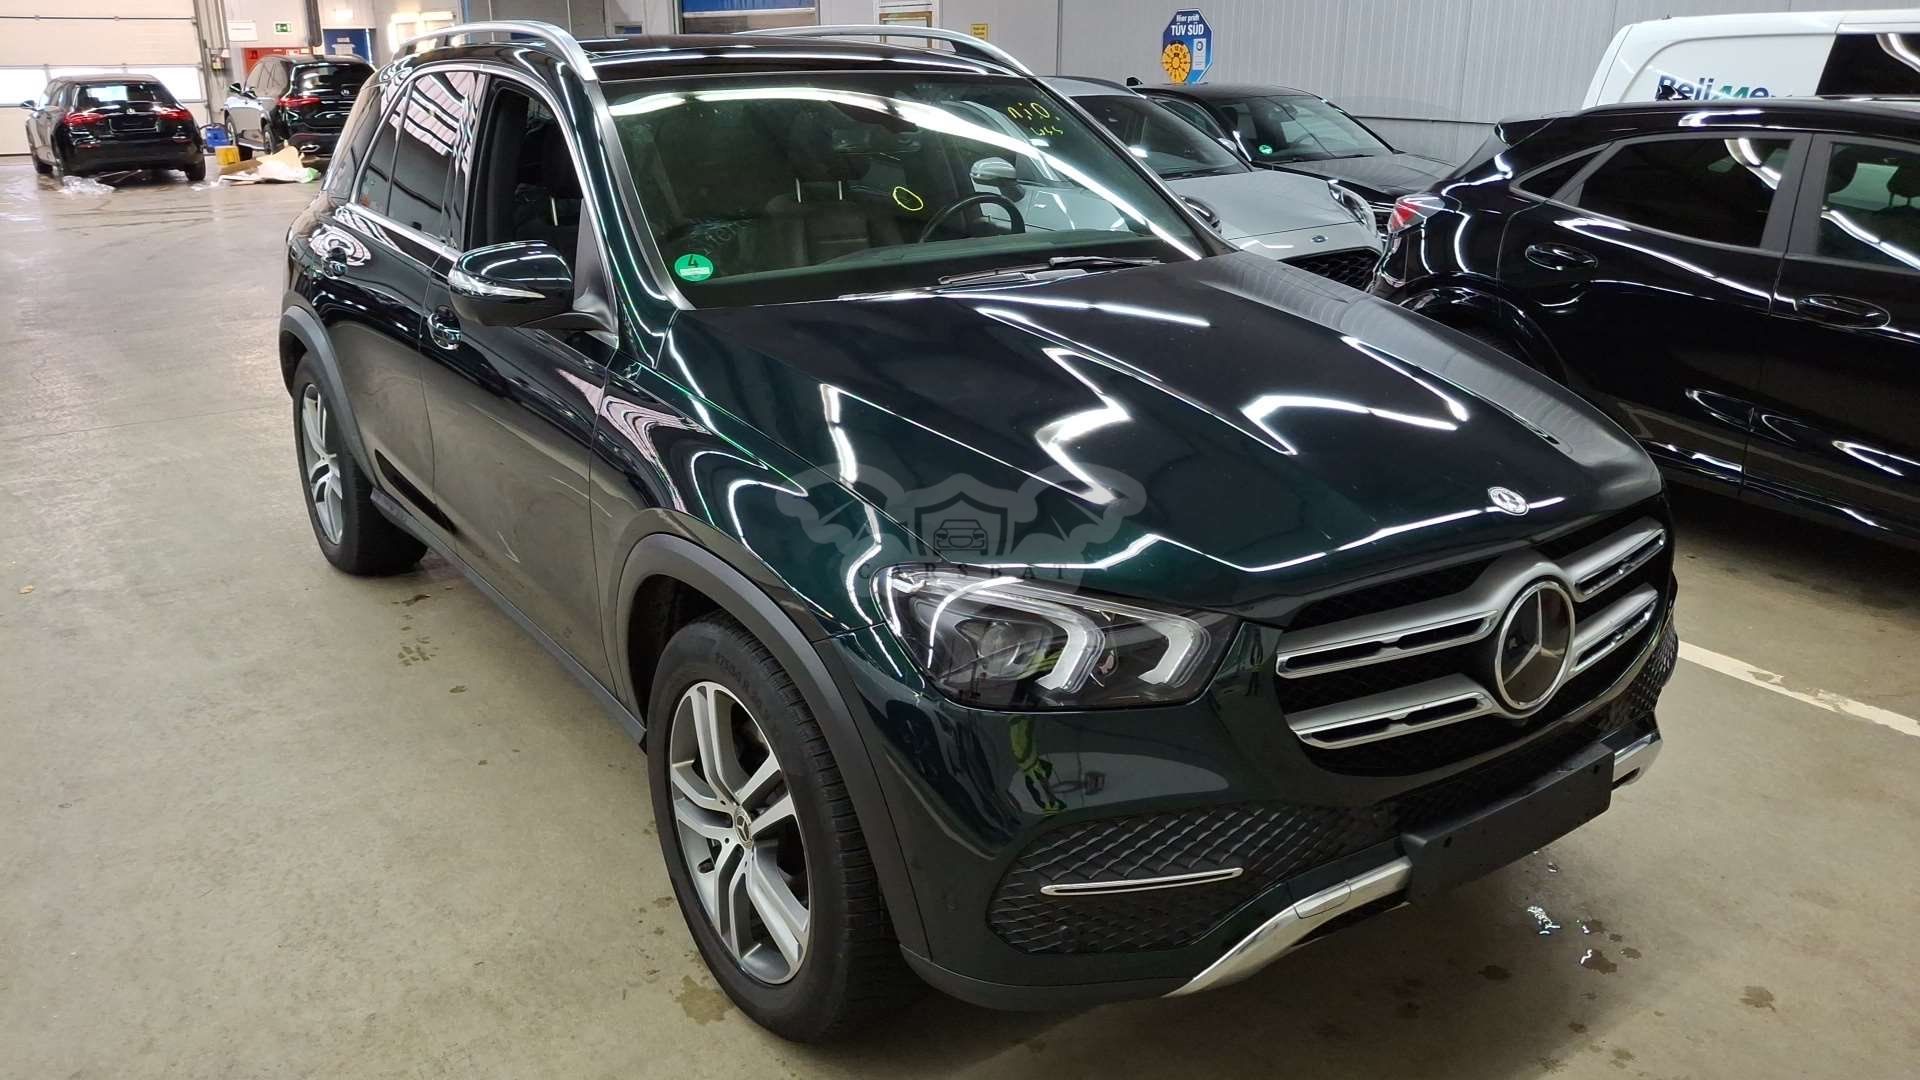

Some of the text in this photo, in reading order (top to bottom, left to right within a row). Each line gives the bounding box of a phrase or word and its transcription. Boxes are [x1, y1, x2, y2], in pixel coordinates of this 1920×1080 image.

[1176, 13, 1200, 23] Hier prüft
[1171, 21, 1204, 36] TÜV SÜD
[687, 254, 700, 268] 4
